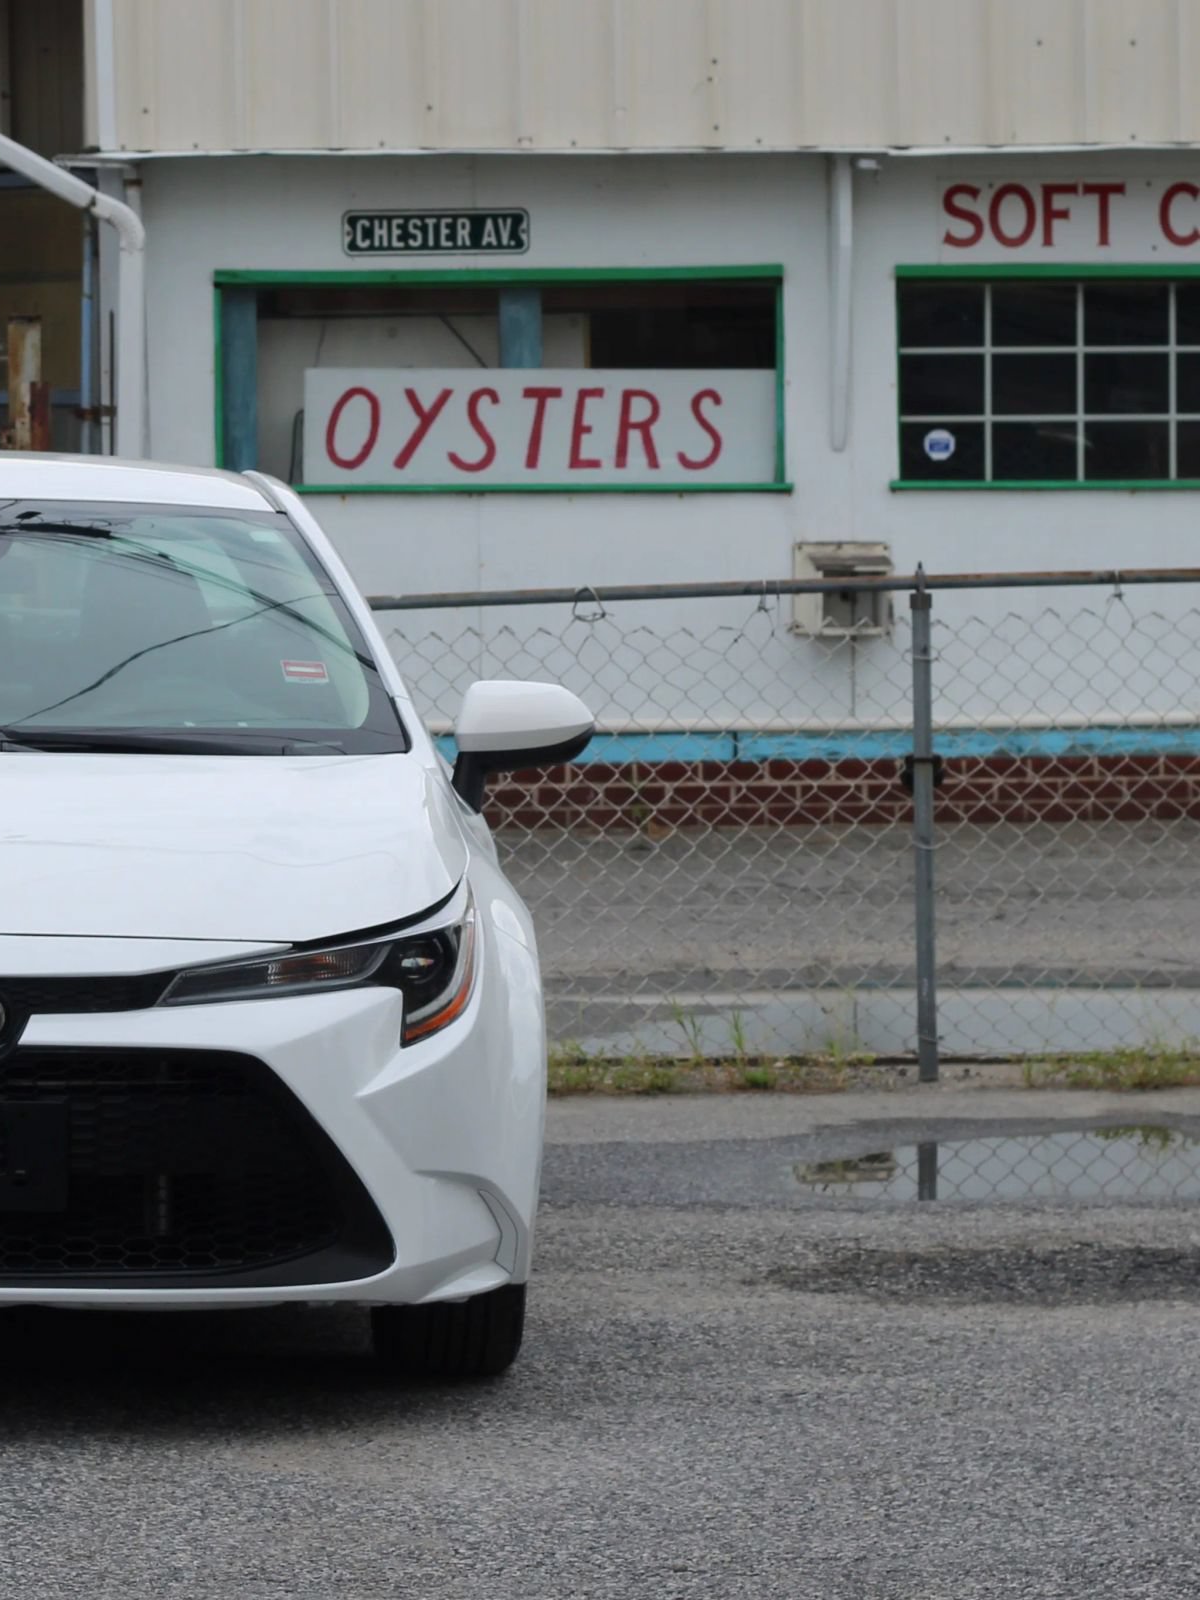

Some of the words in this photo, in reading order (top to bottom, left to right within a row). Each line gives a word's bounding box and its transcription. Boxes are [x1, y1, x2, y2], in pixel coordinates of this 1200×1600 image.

[356, 217, 471, 249] CHESTER
[481, 216, 516, 247] AV.
[943, 183, 1126, 248] SOFT
[325, 386, 723, 473] OYSTERS
